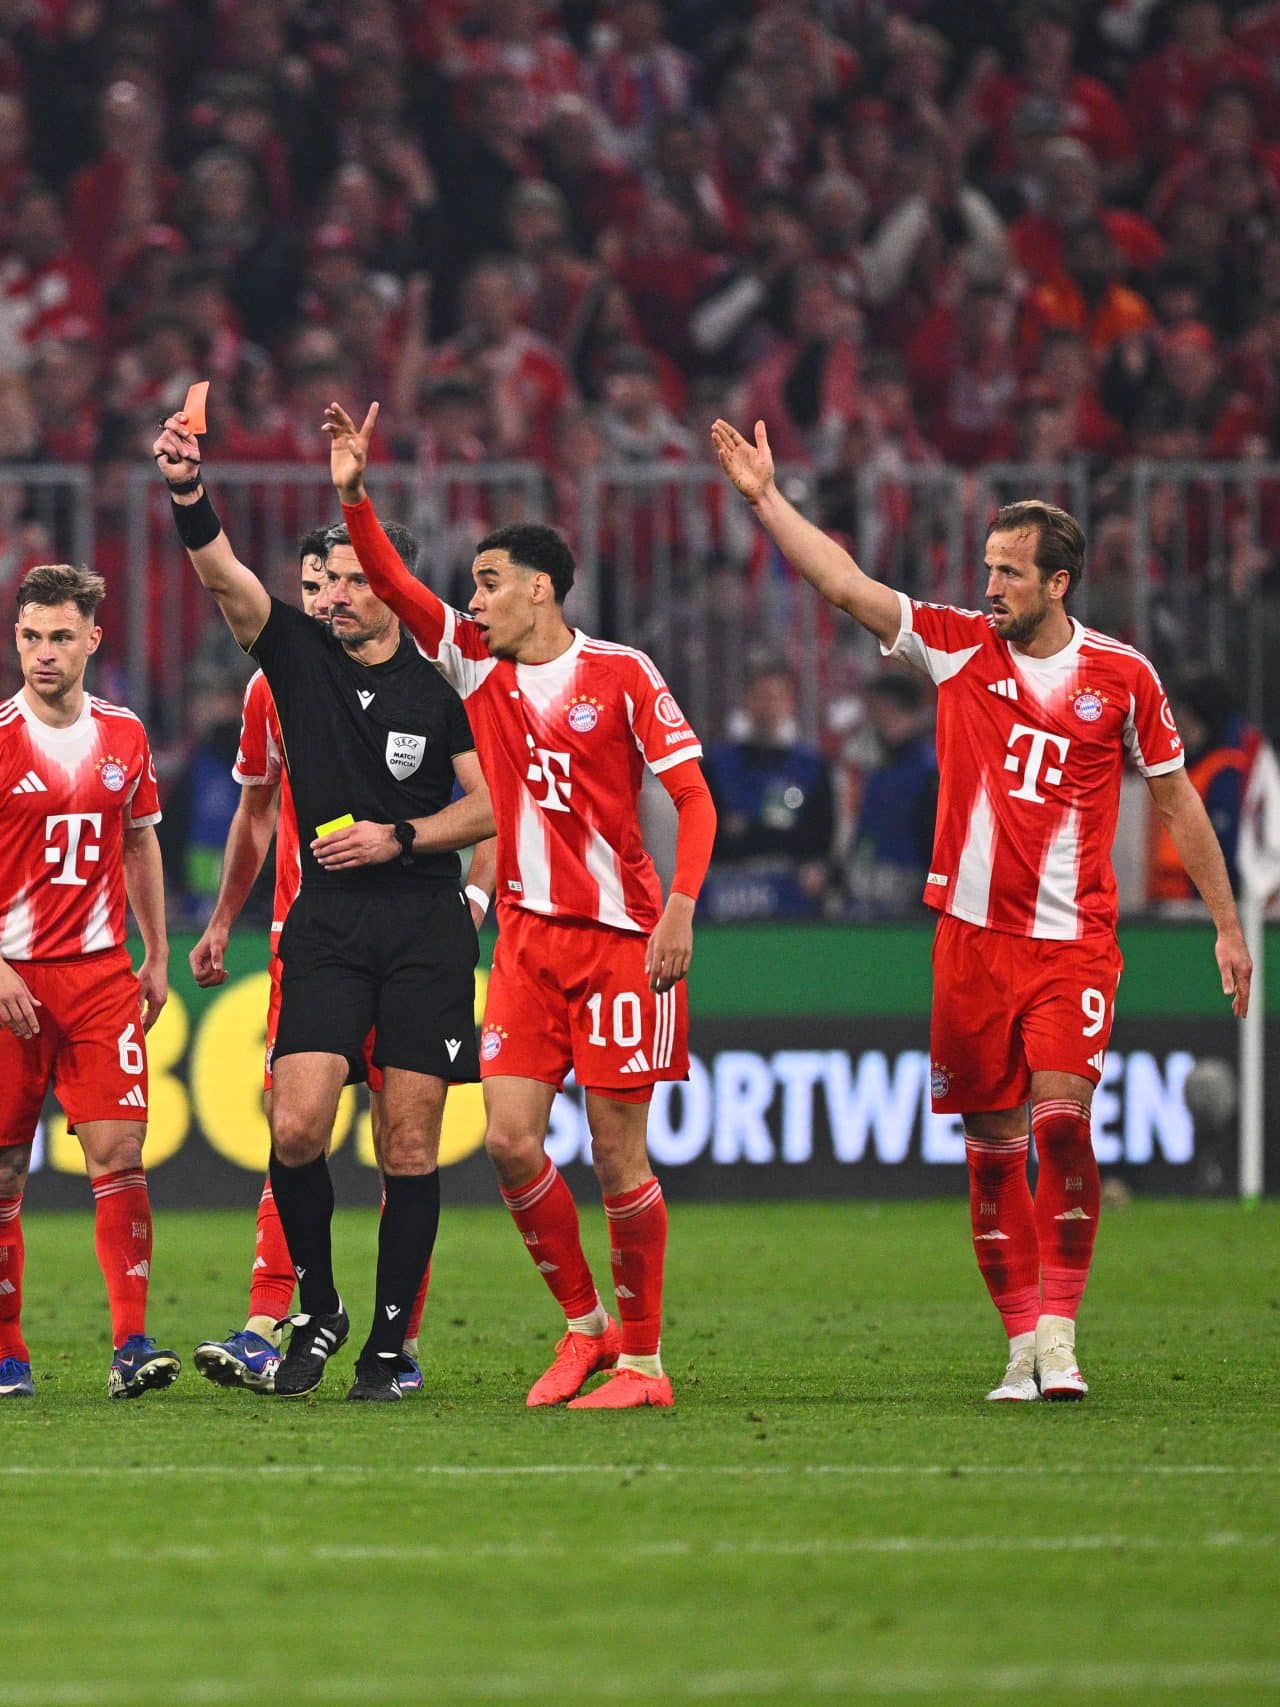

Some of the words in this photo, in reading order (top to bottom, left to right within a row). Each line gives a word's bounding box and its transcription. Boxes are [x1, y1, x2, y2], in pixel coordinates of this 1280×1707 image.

[390, 759, 416, 768] OFFICIAL
[393, 752, 416, 761] MATCH
[394, 738, 418, 749] UEFA
[586, 991, 642, 1047] 10
[1081, 987, 1106, 1038] 9
[117, 1023, 144, 1075] 6
[542, 1049, 1195, 1167] SORTWEN
